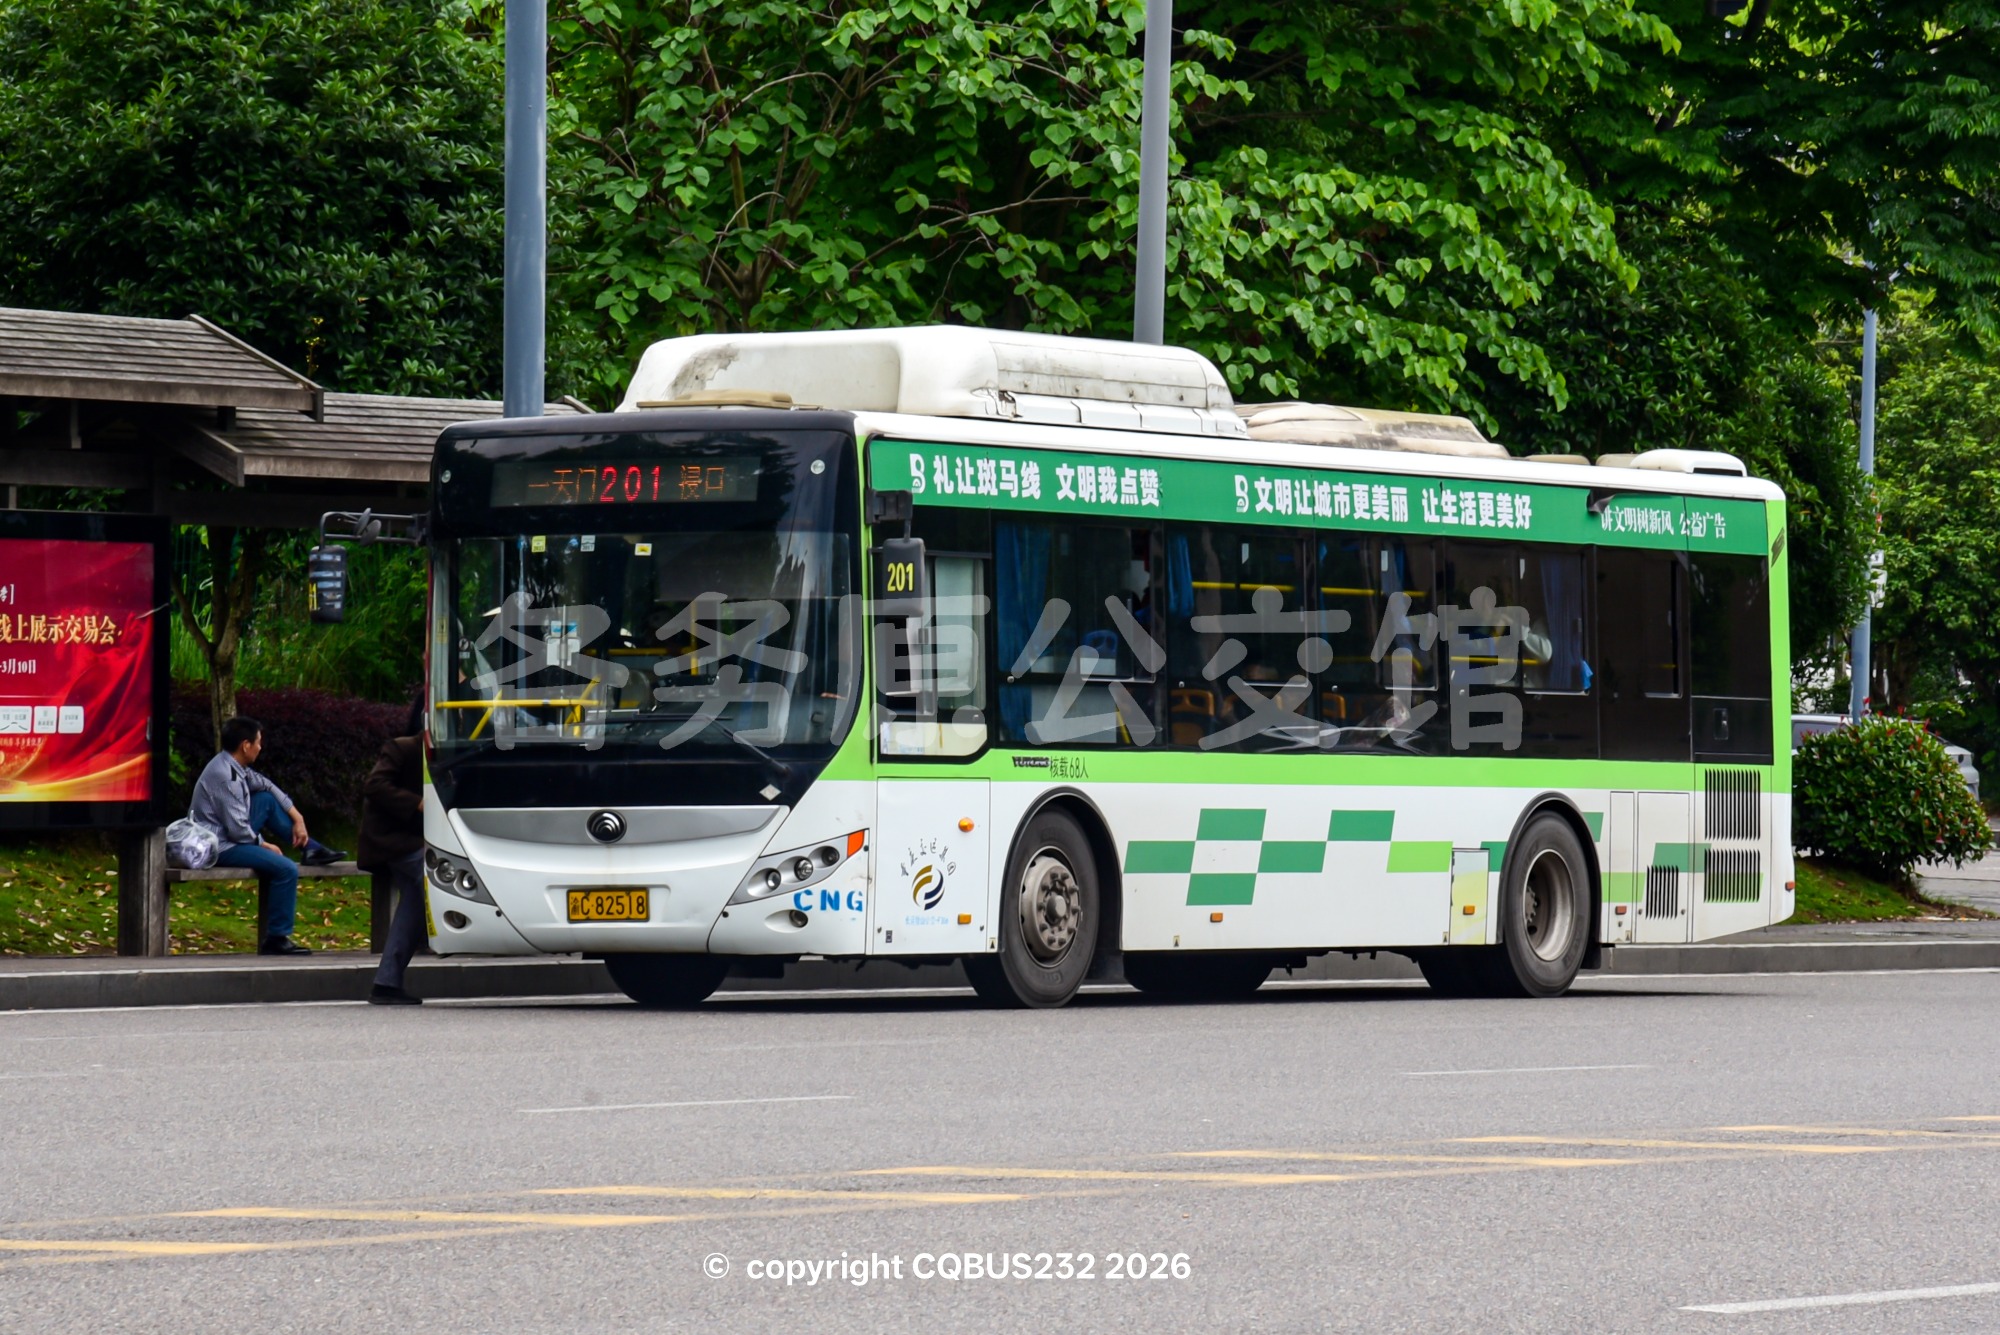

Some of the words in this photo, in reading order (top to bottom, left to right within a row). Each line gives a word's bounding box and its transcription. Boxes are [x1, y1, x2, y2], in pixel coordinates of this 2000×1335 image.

[528, 468, 597, 503] 一天门
[600, 466, 661, 502] 201
[933, 455, 1041, 499] 礼让斑马线
[1056, 463, 1159, 506] 文明我点赞
[1254, 476, 1408, 523] 文明让城市更美丽
[1421, 491, 1532, 530] 让生活更美好
[1679, 512, 1726, 538] 公益广告
[887, 563, 914, 591] 201
[1050, 756, 1089, 779] 核载68人
[794, 889, 863, 912] CNG
